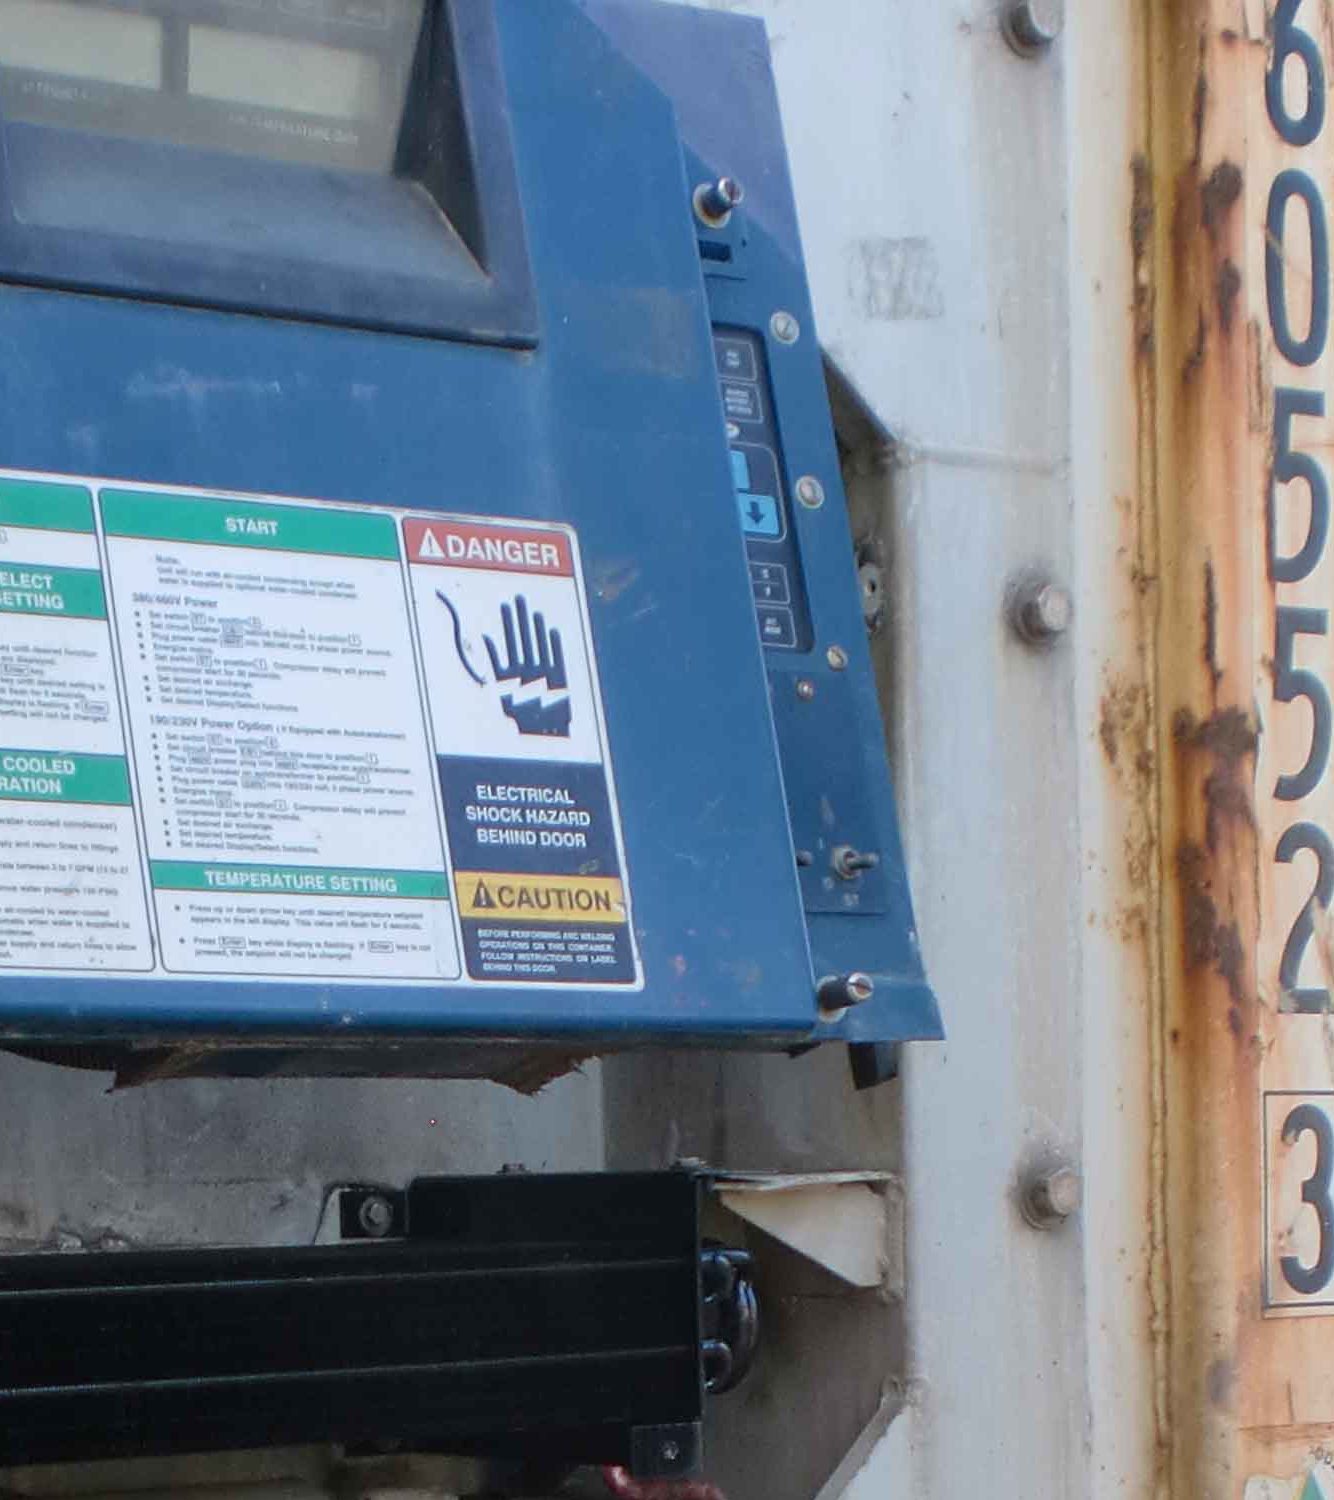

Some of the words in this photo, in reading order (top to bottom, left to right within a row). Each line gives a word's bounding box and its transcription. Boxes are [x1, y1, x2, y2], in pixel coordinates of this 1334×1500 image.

[223, 516, 279, 536] START
[445, 533, 560, 568] DANGER
[183, 595, 218, 608] Power
[2, 755, 76, 775] COOLED
[475, 784, 575, 804] ELECTRICAL
[465, 805, 523, 823] SHOCK
[525, 808, 591, 826] HAZARD
[475, 827, 537, 845] BEHIND
[539, 830, 587, 847] DOOR
[204, 870, 326, 890] TEMPERATURE
[328, 875, 398, 892] SETTING
[496, 885, 612, 912] CAUTION
[478, 940, 530, 950] OPERATIONS
[532, 941, 545, 950] ON
[547, 942, 565, 951] THIS
[480, 951, 514, 961] FOLLOW
[515, 952, 573, 962] INSTRUCTIONS
[575, 954, 588, 963] ON
[590, 954, 616, 964] LABEL
[482, 962, 512, 971] BEHIND
[513, 963, 531, 972] THIS
